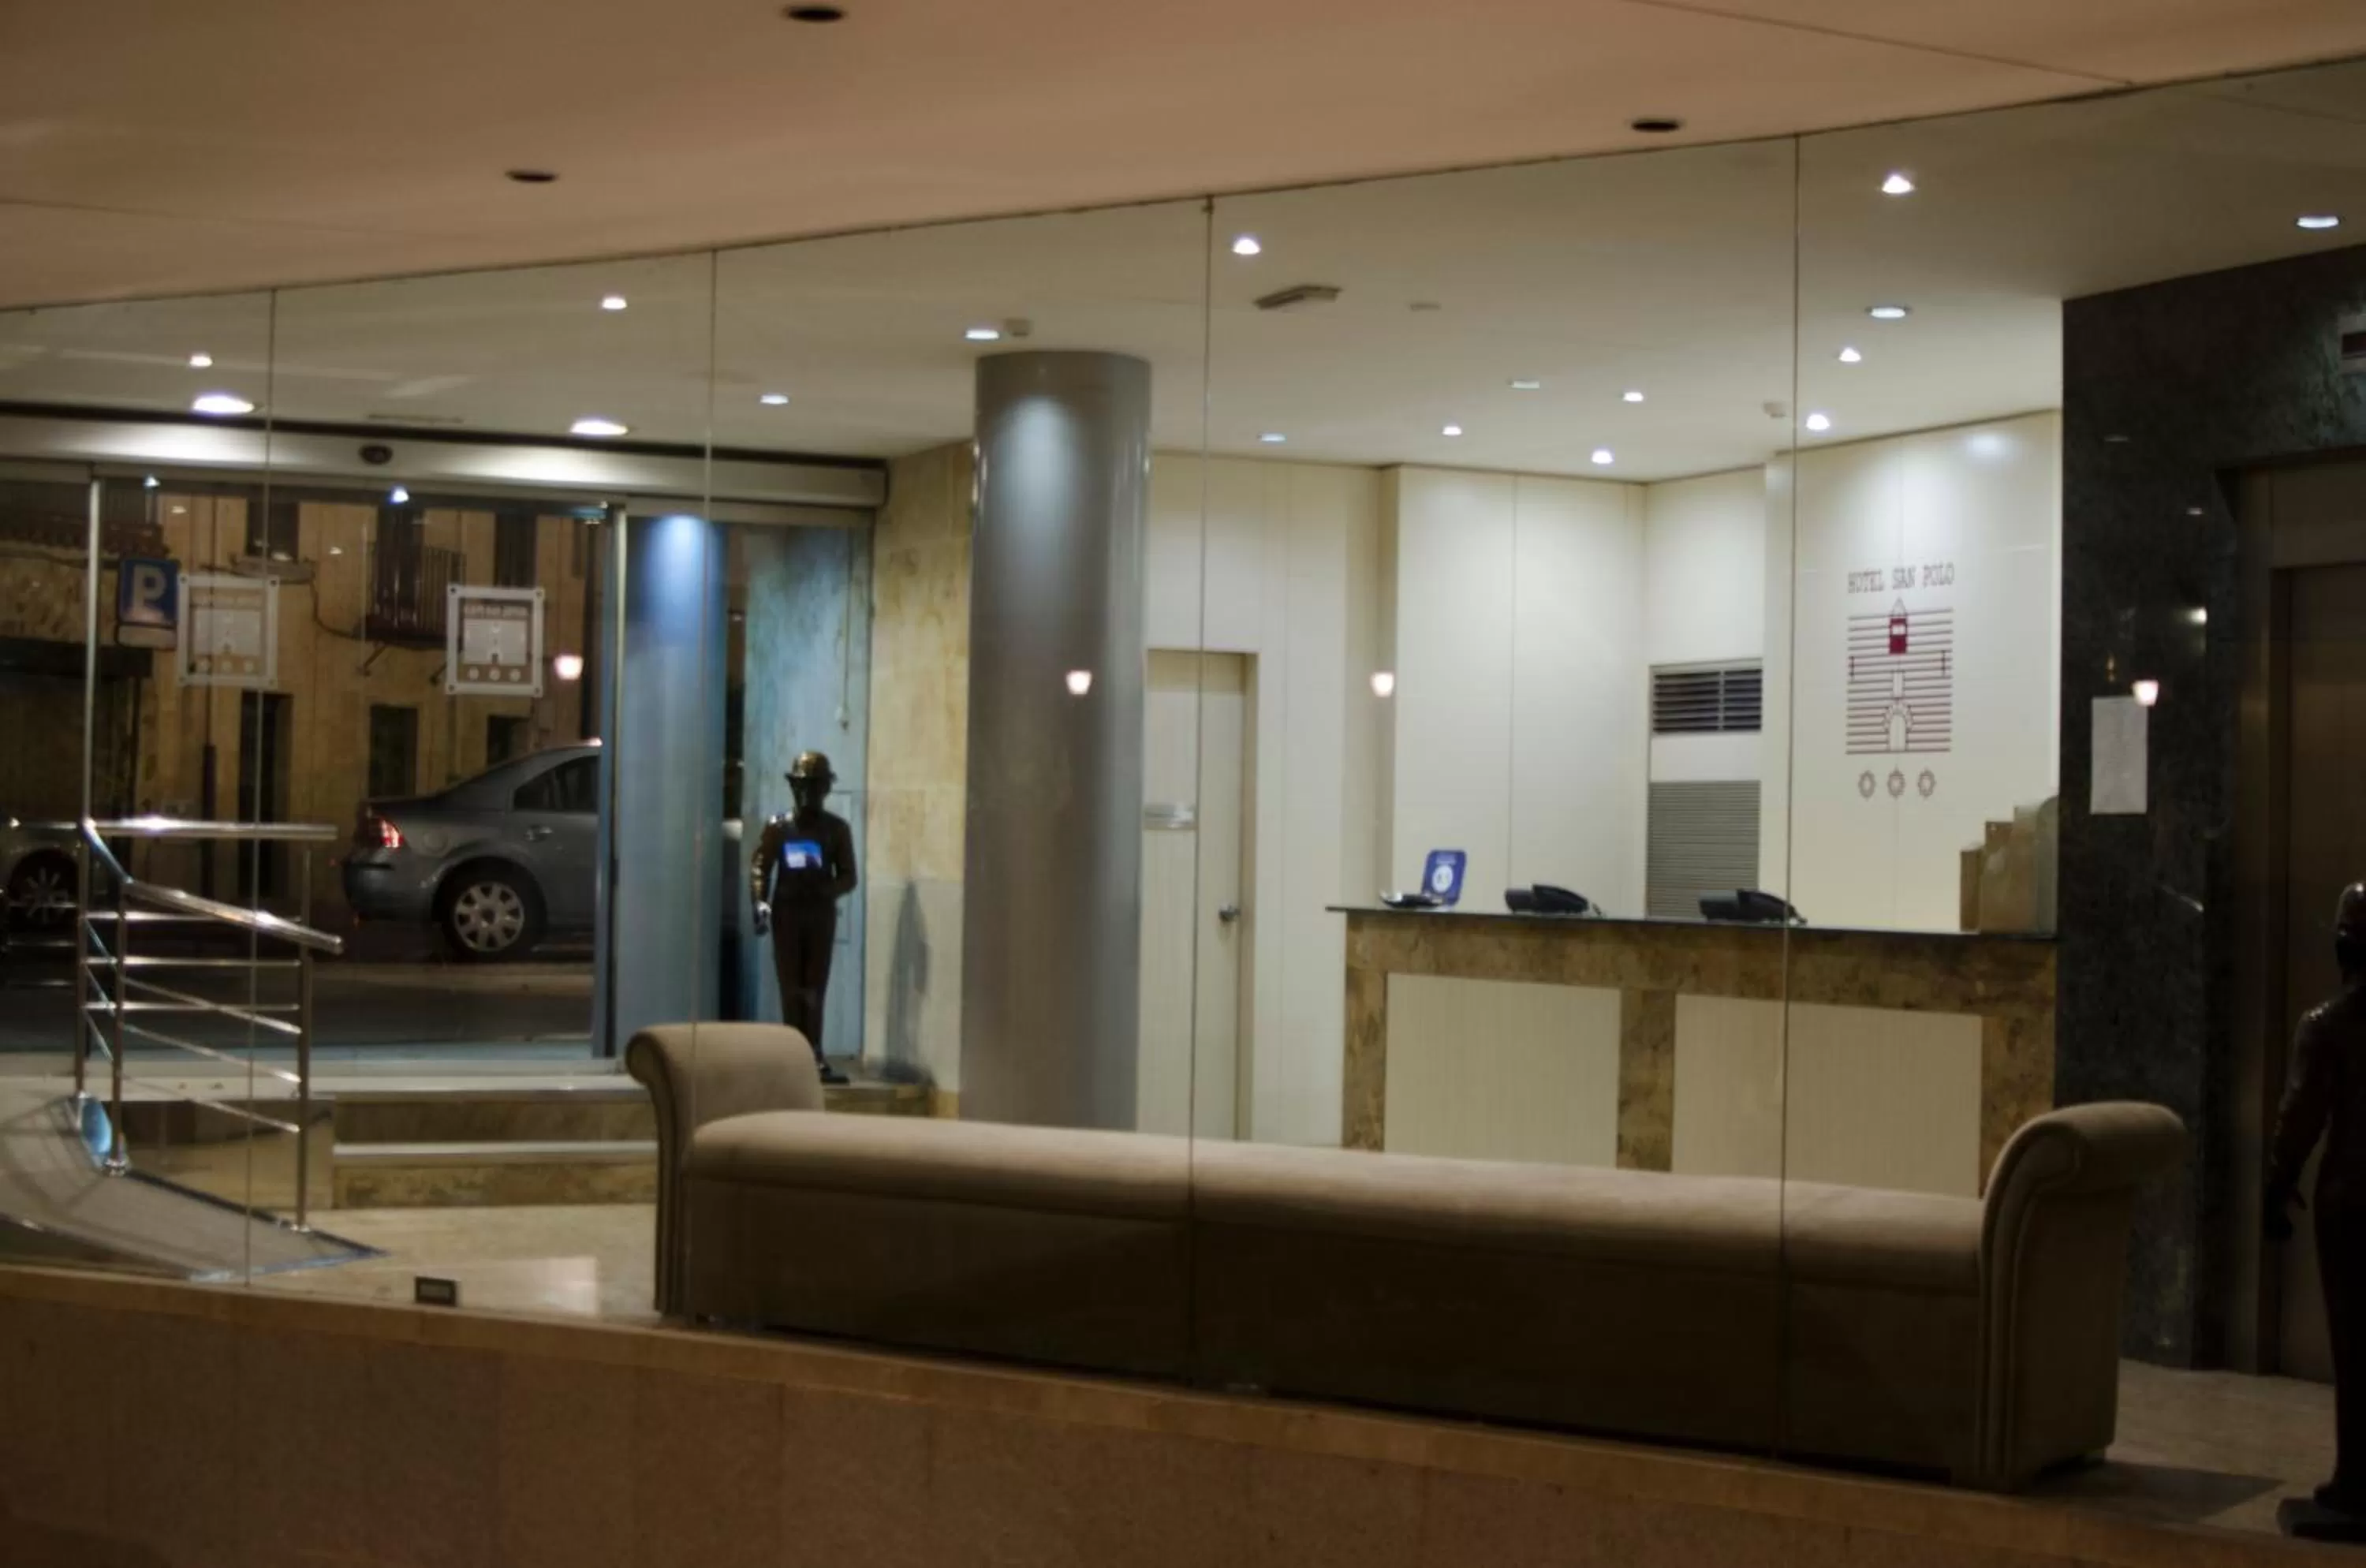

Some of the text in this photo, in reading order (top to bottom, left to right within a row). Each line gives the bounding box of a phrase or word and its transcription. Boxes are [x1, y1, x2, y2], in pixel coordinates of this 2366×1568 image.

[131, 563, 167, 622] P
[1847, 562, 1955, 593] HOTEL SAN POLO
